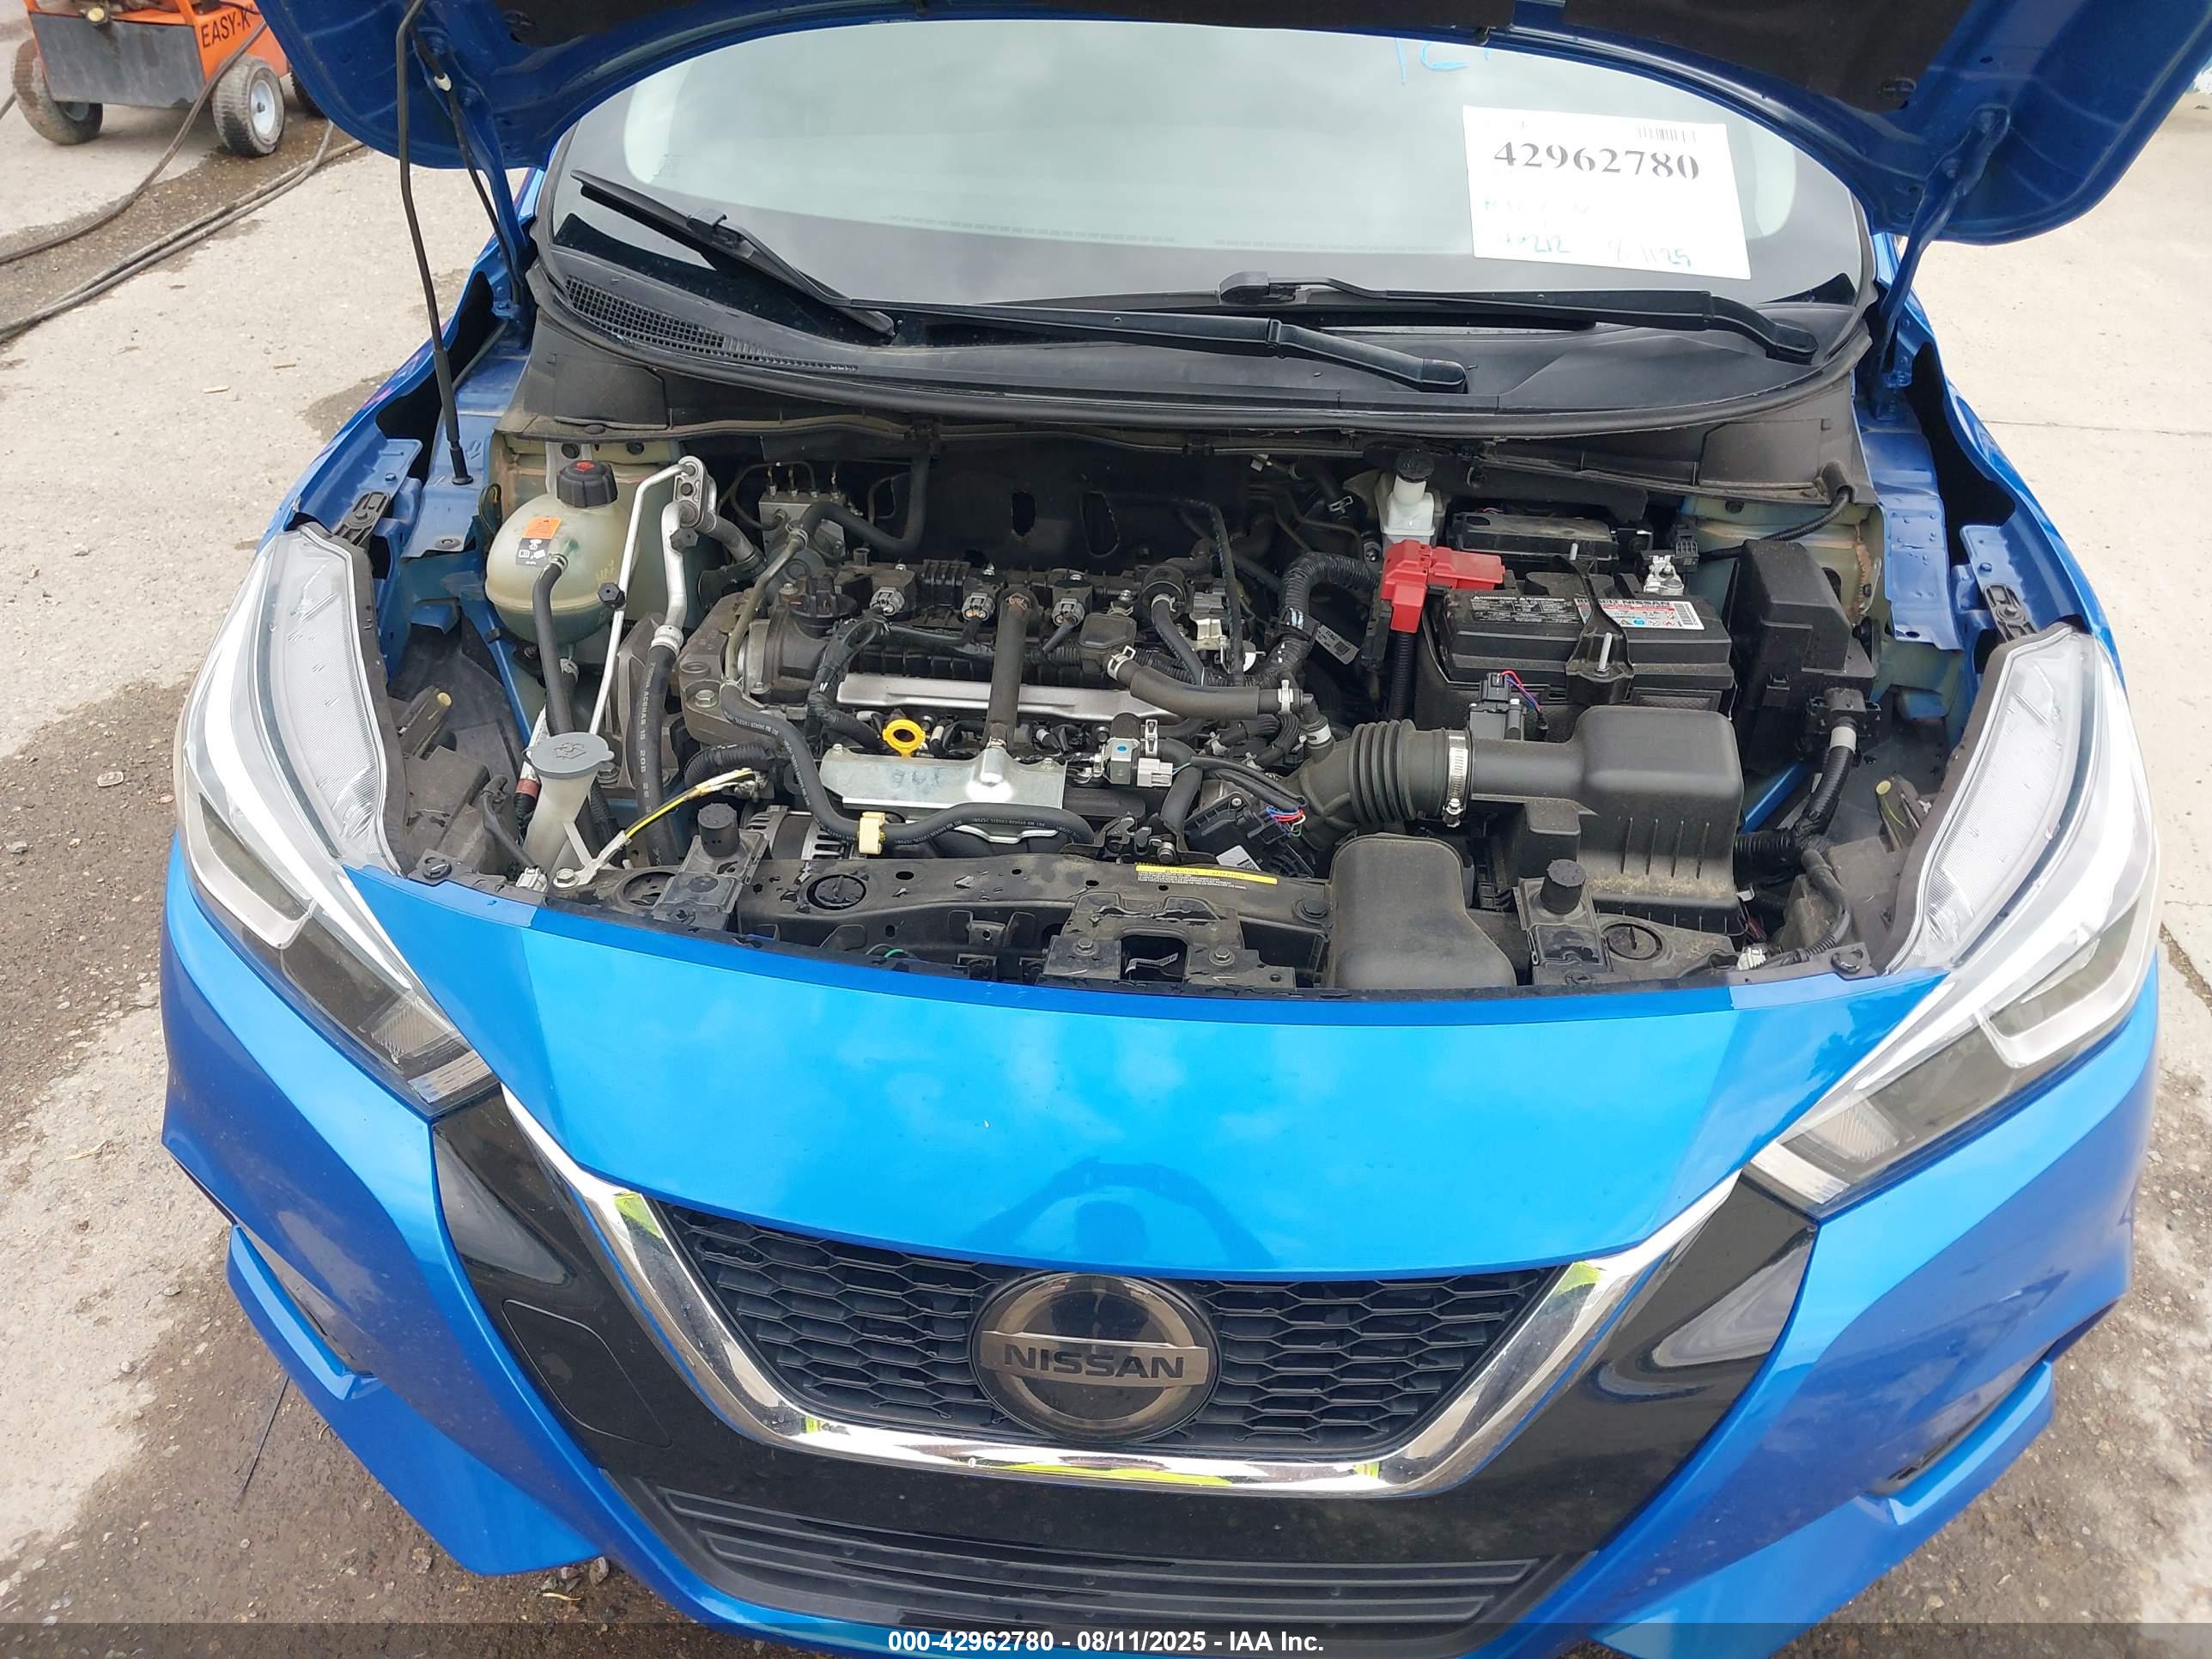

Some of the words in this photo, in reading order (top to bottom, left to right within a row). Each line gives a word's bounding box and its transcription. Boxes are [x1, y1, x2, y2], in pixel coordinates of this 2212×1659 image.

[201, 9, 251, 48] EASY-K
[1493, 141, 1699, 180] 42962780
[1003, 1343, 1185, 1379] NISSAN
